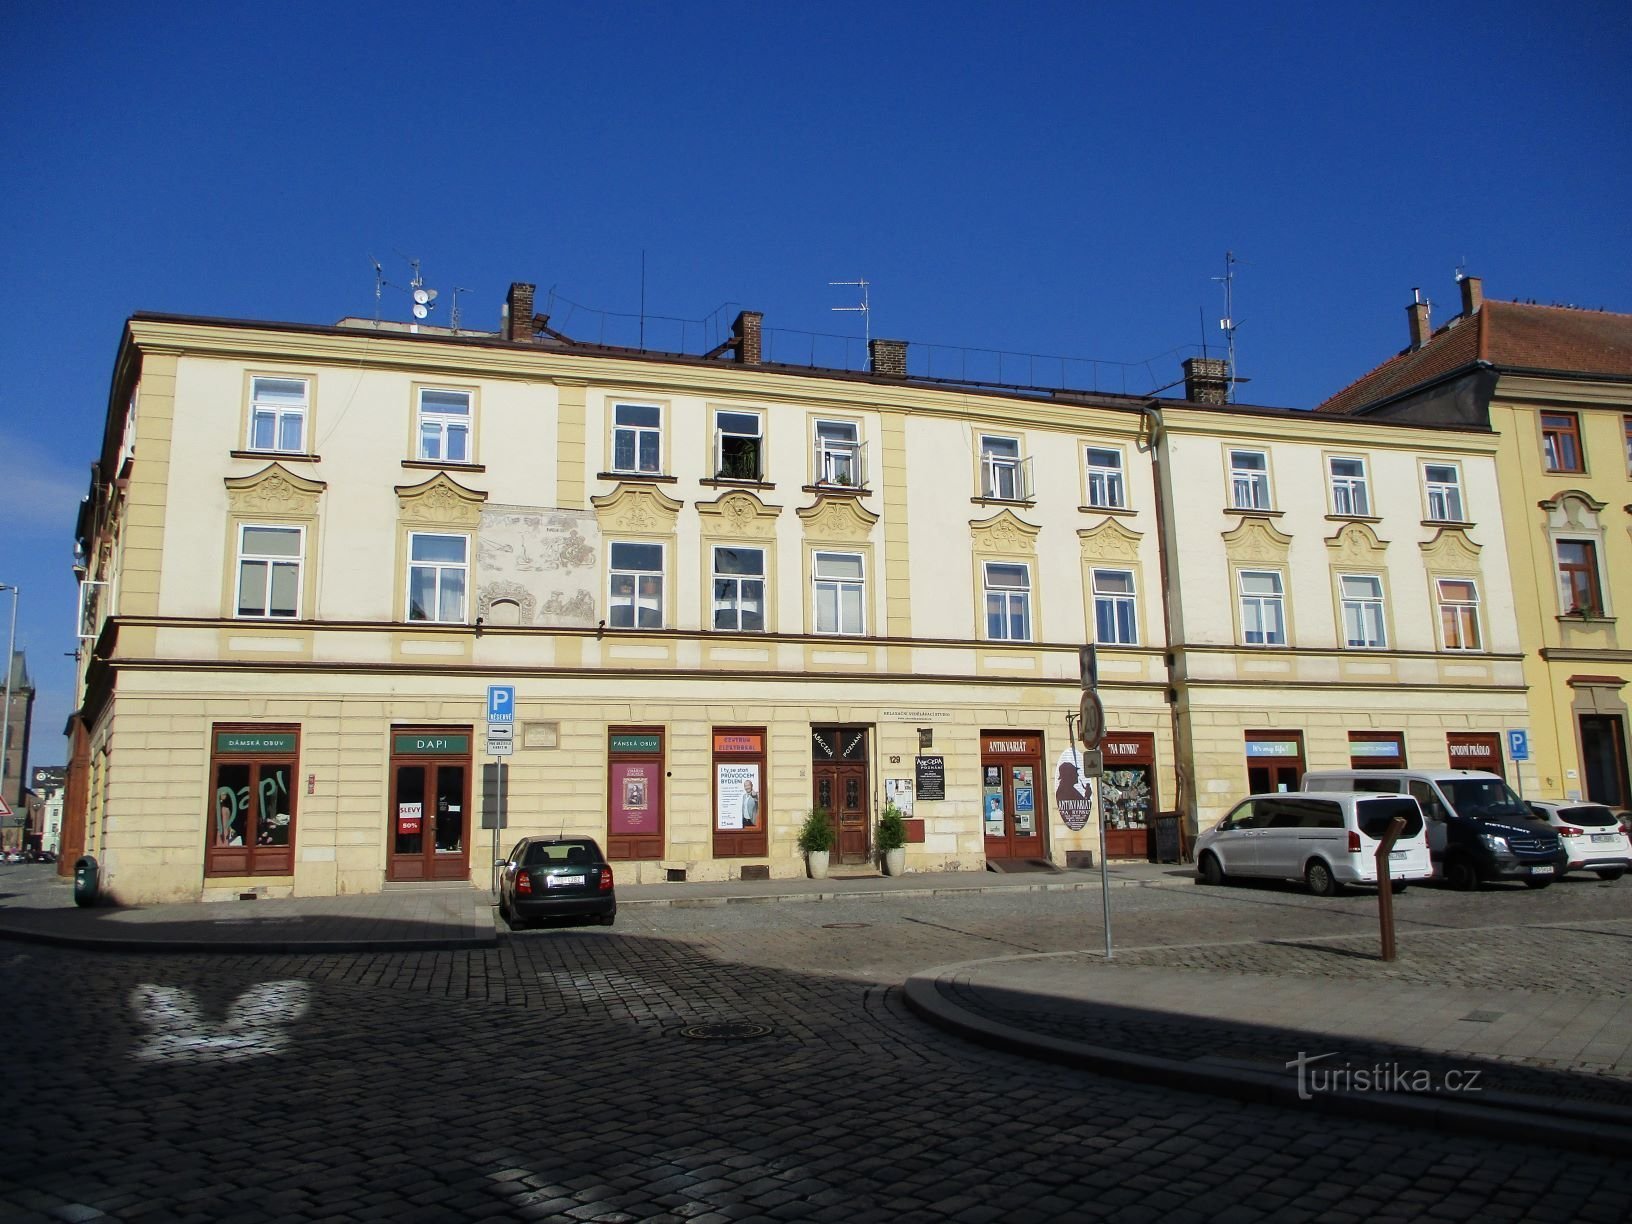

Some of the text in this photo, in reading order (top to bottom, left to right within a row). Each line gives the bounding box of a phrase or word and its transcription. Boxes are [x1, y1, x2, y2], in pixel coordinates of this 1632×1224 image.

[493, 690, 509, 710] P
[417, 740, 447, 749] DAPI
[813, 732, 834, 757] ABECEDA
[842, 732, 863, 757] POZNÁNÍ
[988, 739, 1026, 753] ANTIKVARIÁT
[1450, 744, 1490, 756] SPODNÍ PRÁDLO
[1512, 734, 1523, 751] P
[890, 755, 900, 764] 129
